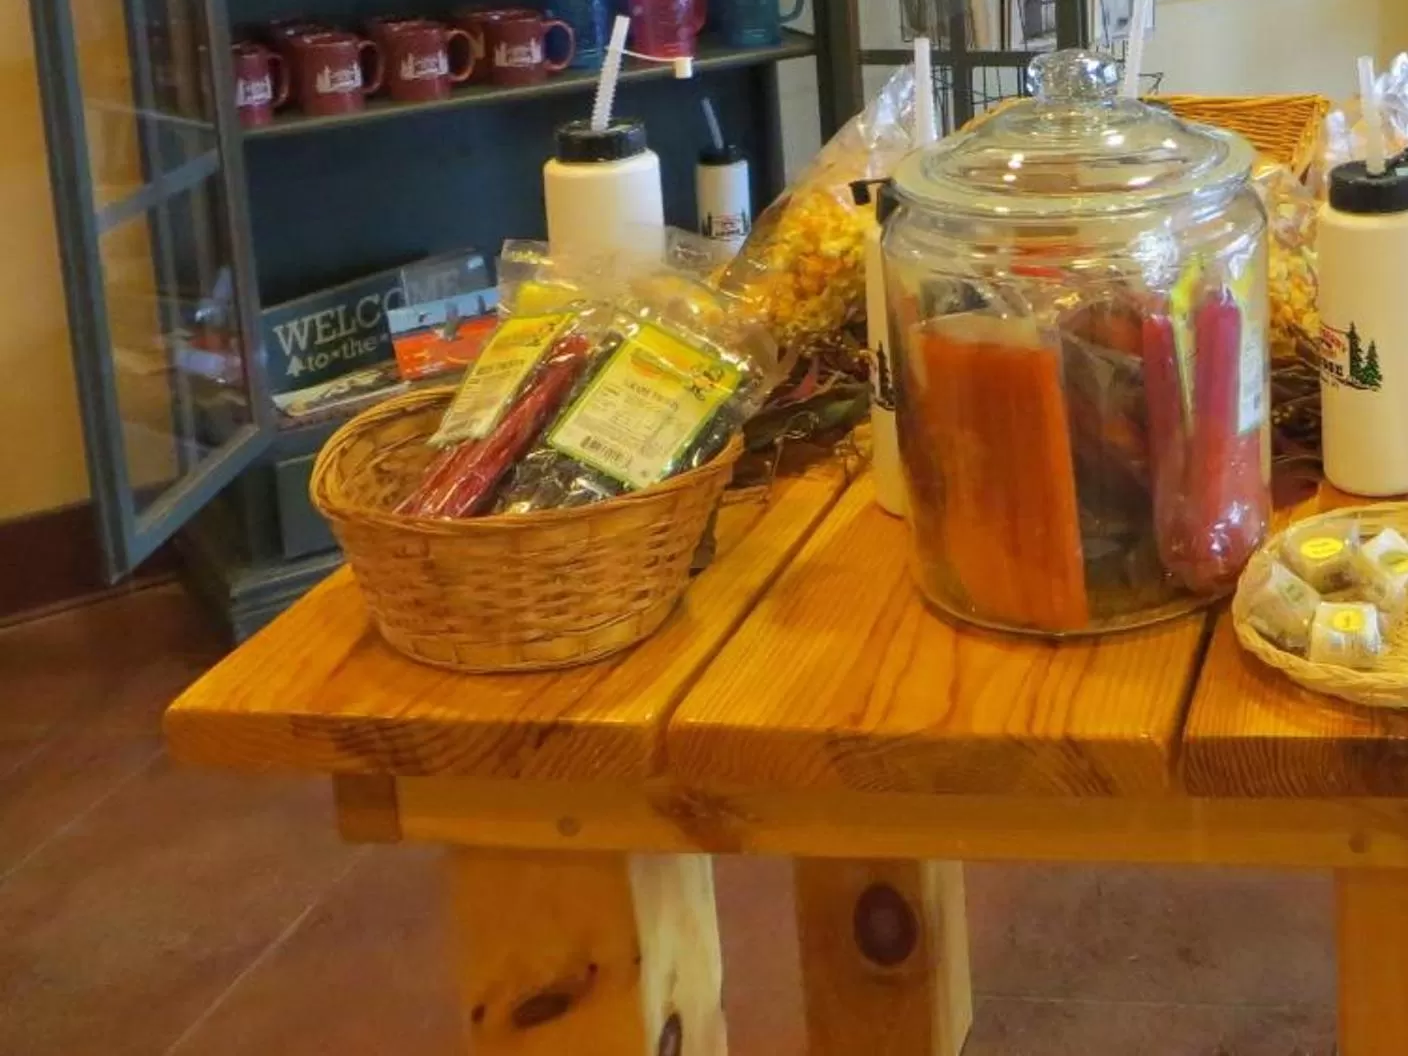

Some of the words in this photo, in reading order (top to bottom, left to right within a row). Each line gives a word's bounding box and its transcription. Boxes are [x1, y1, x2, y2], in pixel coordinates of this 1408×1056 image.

[272, 268, 461, 356] WELCOME
[306, 352, 329, 373] to
[342, 334, 378, 360] the
